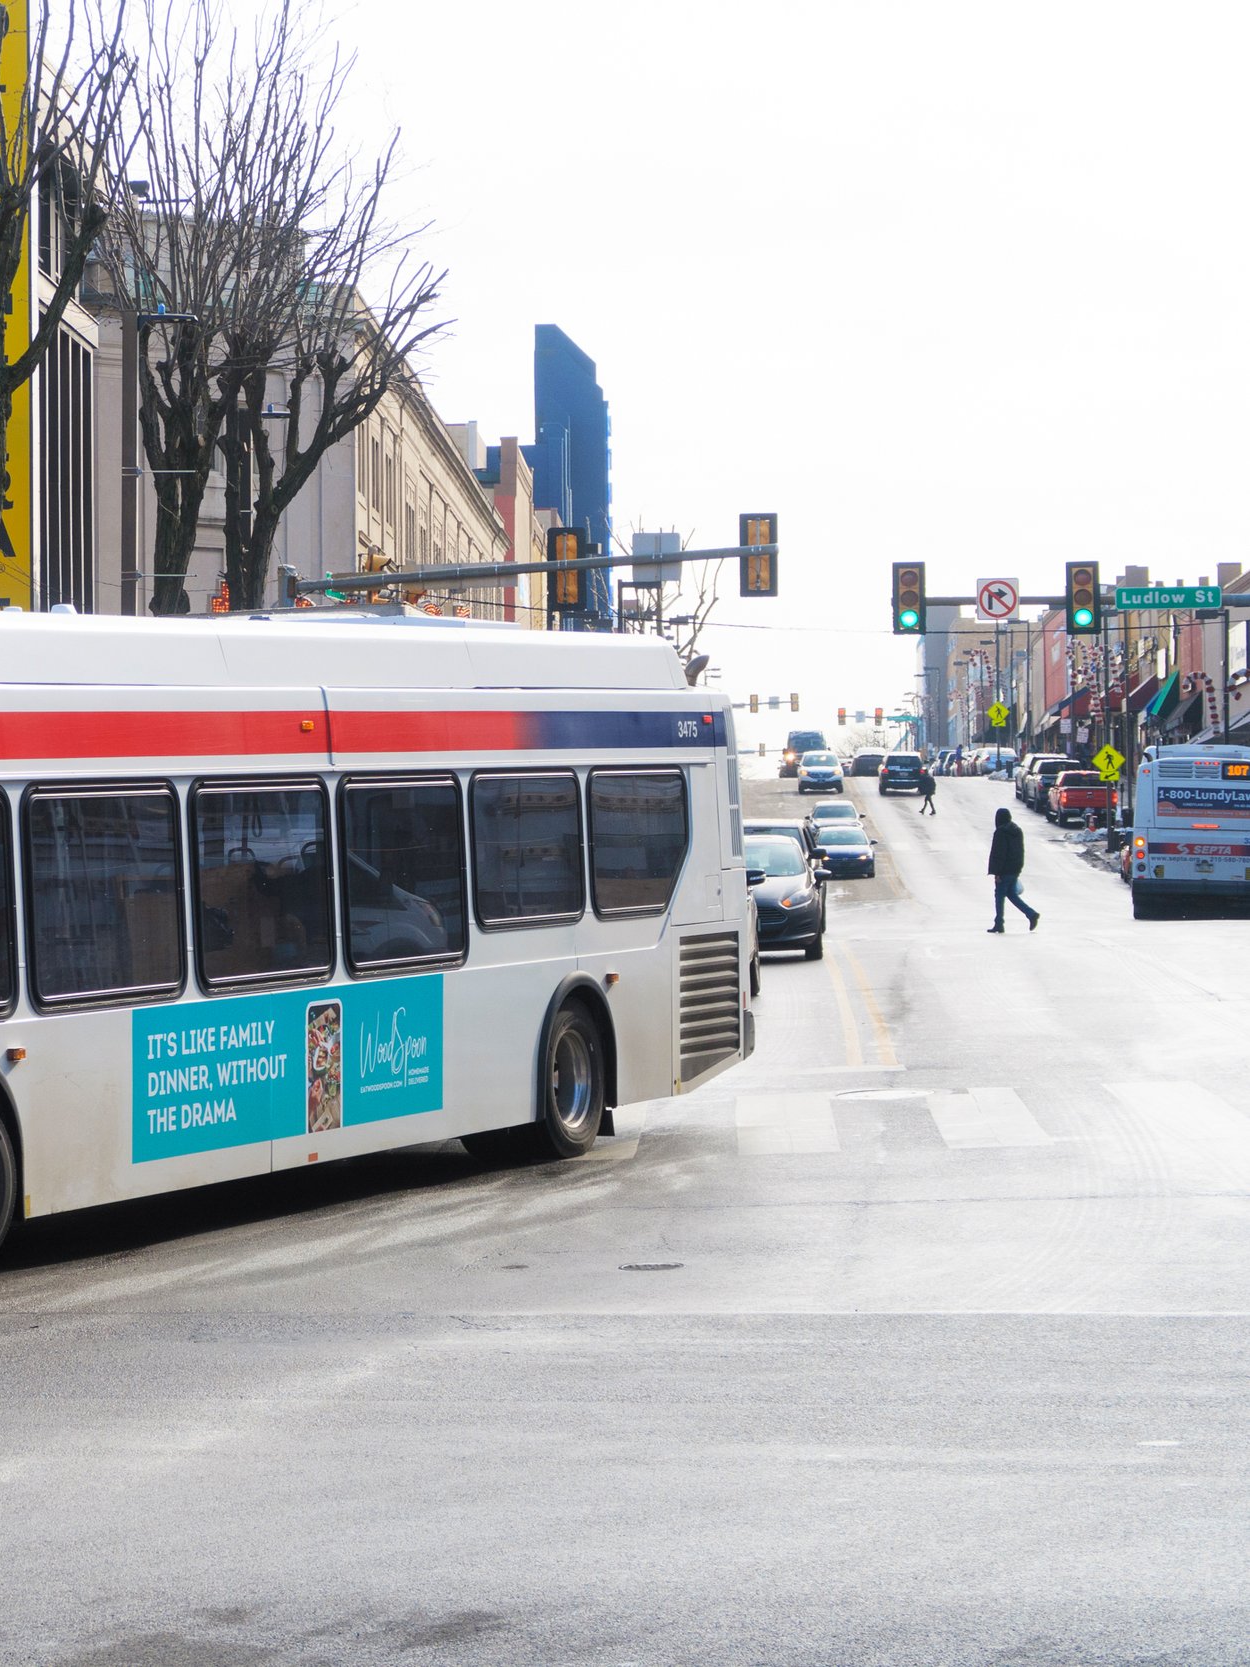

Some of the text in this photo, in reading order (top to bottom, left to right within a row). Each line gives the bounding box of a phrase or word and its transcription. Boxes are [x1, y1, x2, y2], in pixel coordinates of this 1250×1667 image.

[1121, 590, 1214, 604] Ludlow St
[678, 720, 698, 738] 3475
[1227, 765, 1250, 776] 107
[1193, 845, 1231, 855] SEPTA
[147, 1020, 275, 1060] IT'S LIKE FAMILY
[360, 1006, 427, 1087] WoodSpoon
[148, 1053, 287, 1097] DINNER, WITHOUT
[408, 1075, 429, 1085] DELIVERED
[147, 1097, 237, 1135] THE DRAMA
